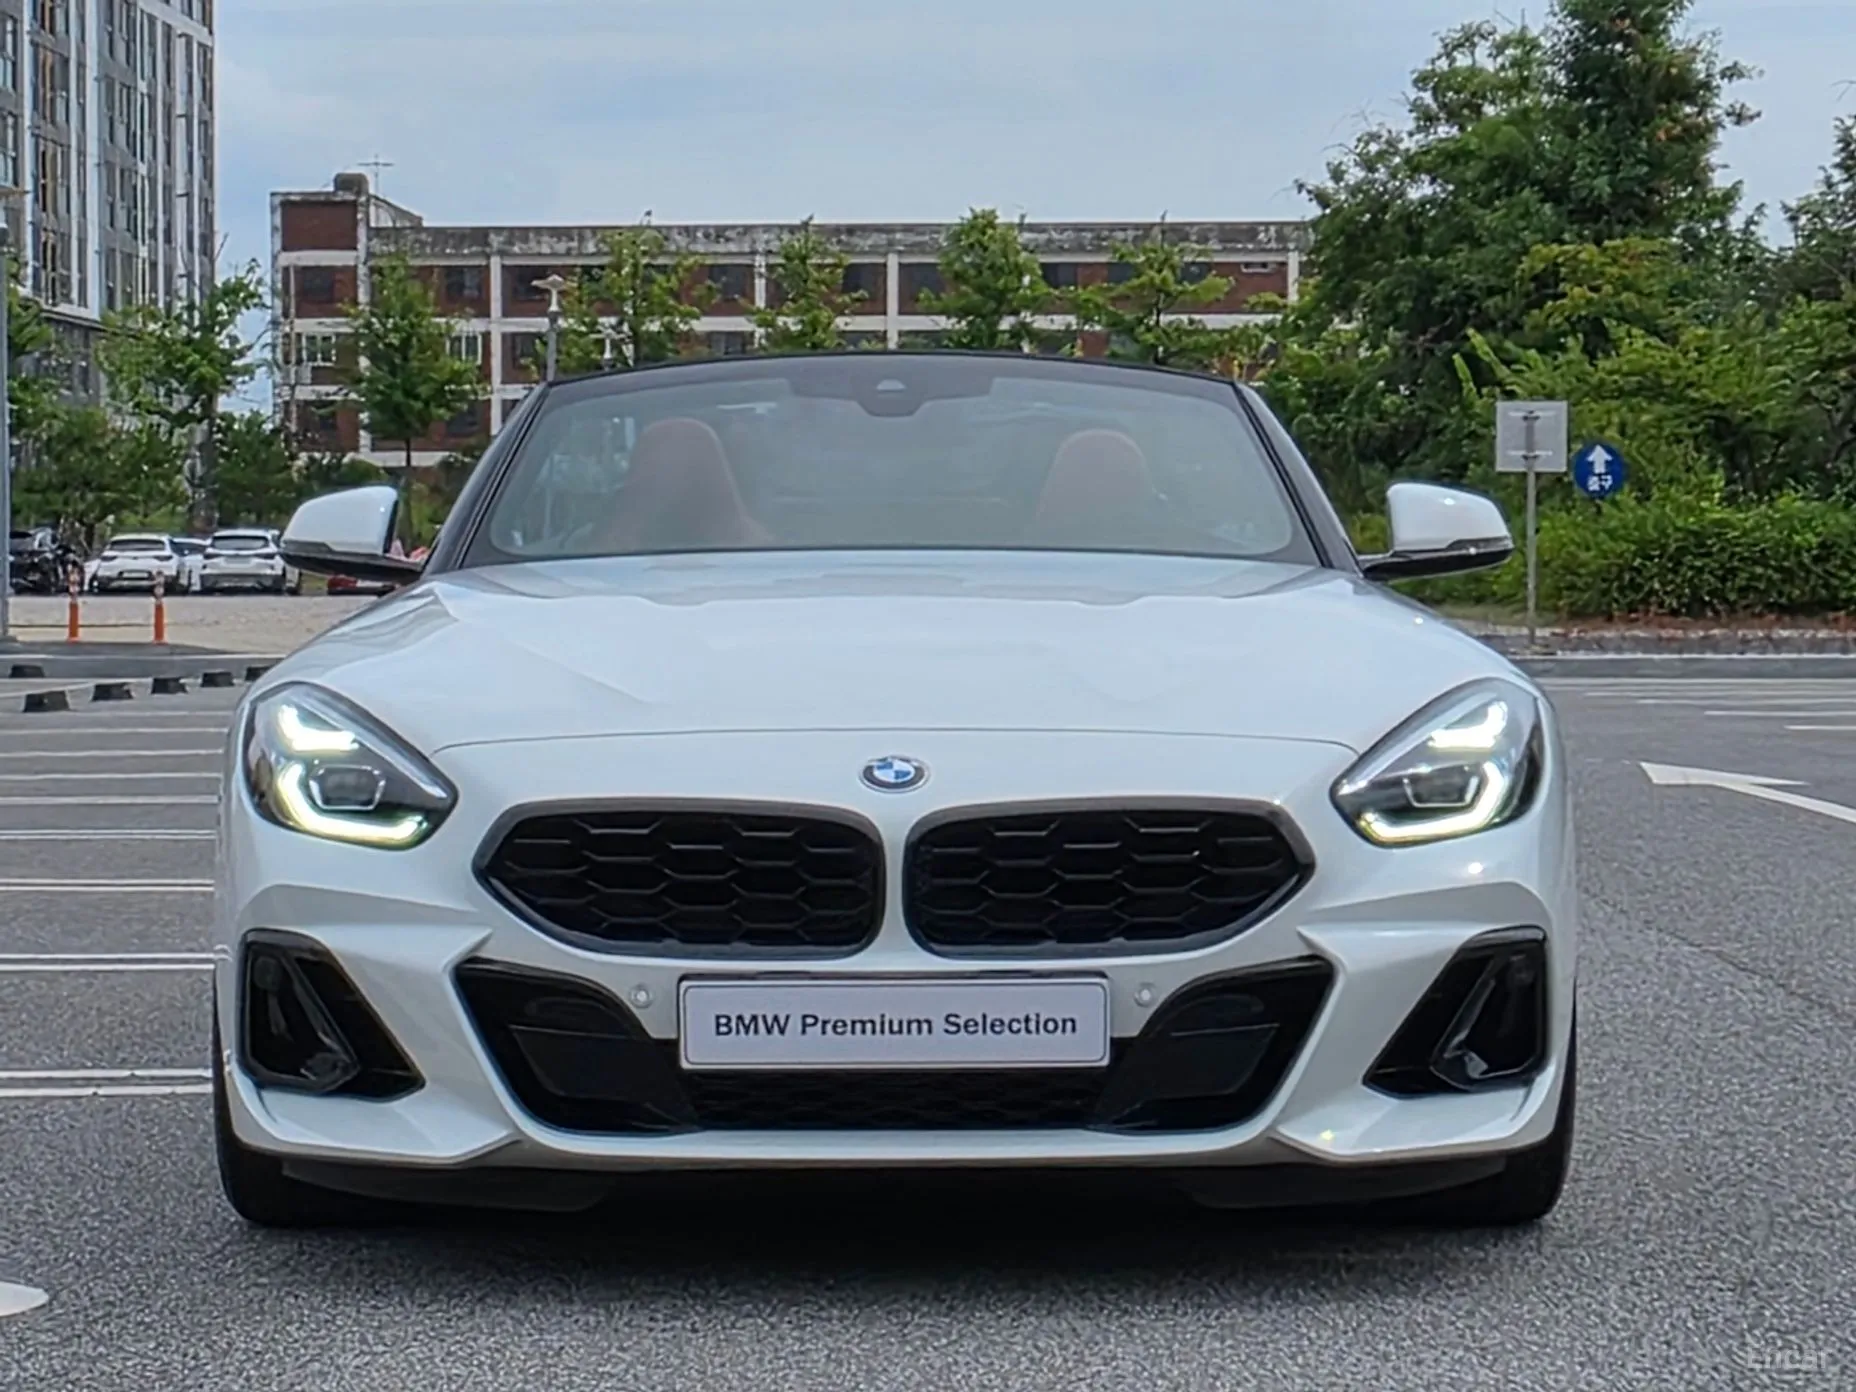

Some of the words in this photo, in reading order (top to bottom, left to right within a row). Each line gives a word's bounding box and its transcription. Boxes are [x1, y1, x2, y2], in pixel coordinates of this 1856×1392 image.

[714, 1013, 791, 1037] BMW
[800, 1013, 933, 1037] Premium
[942, 1012, 1078, 1036] Selection
